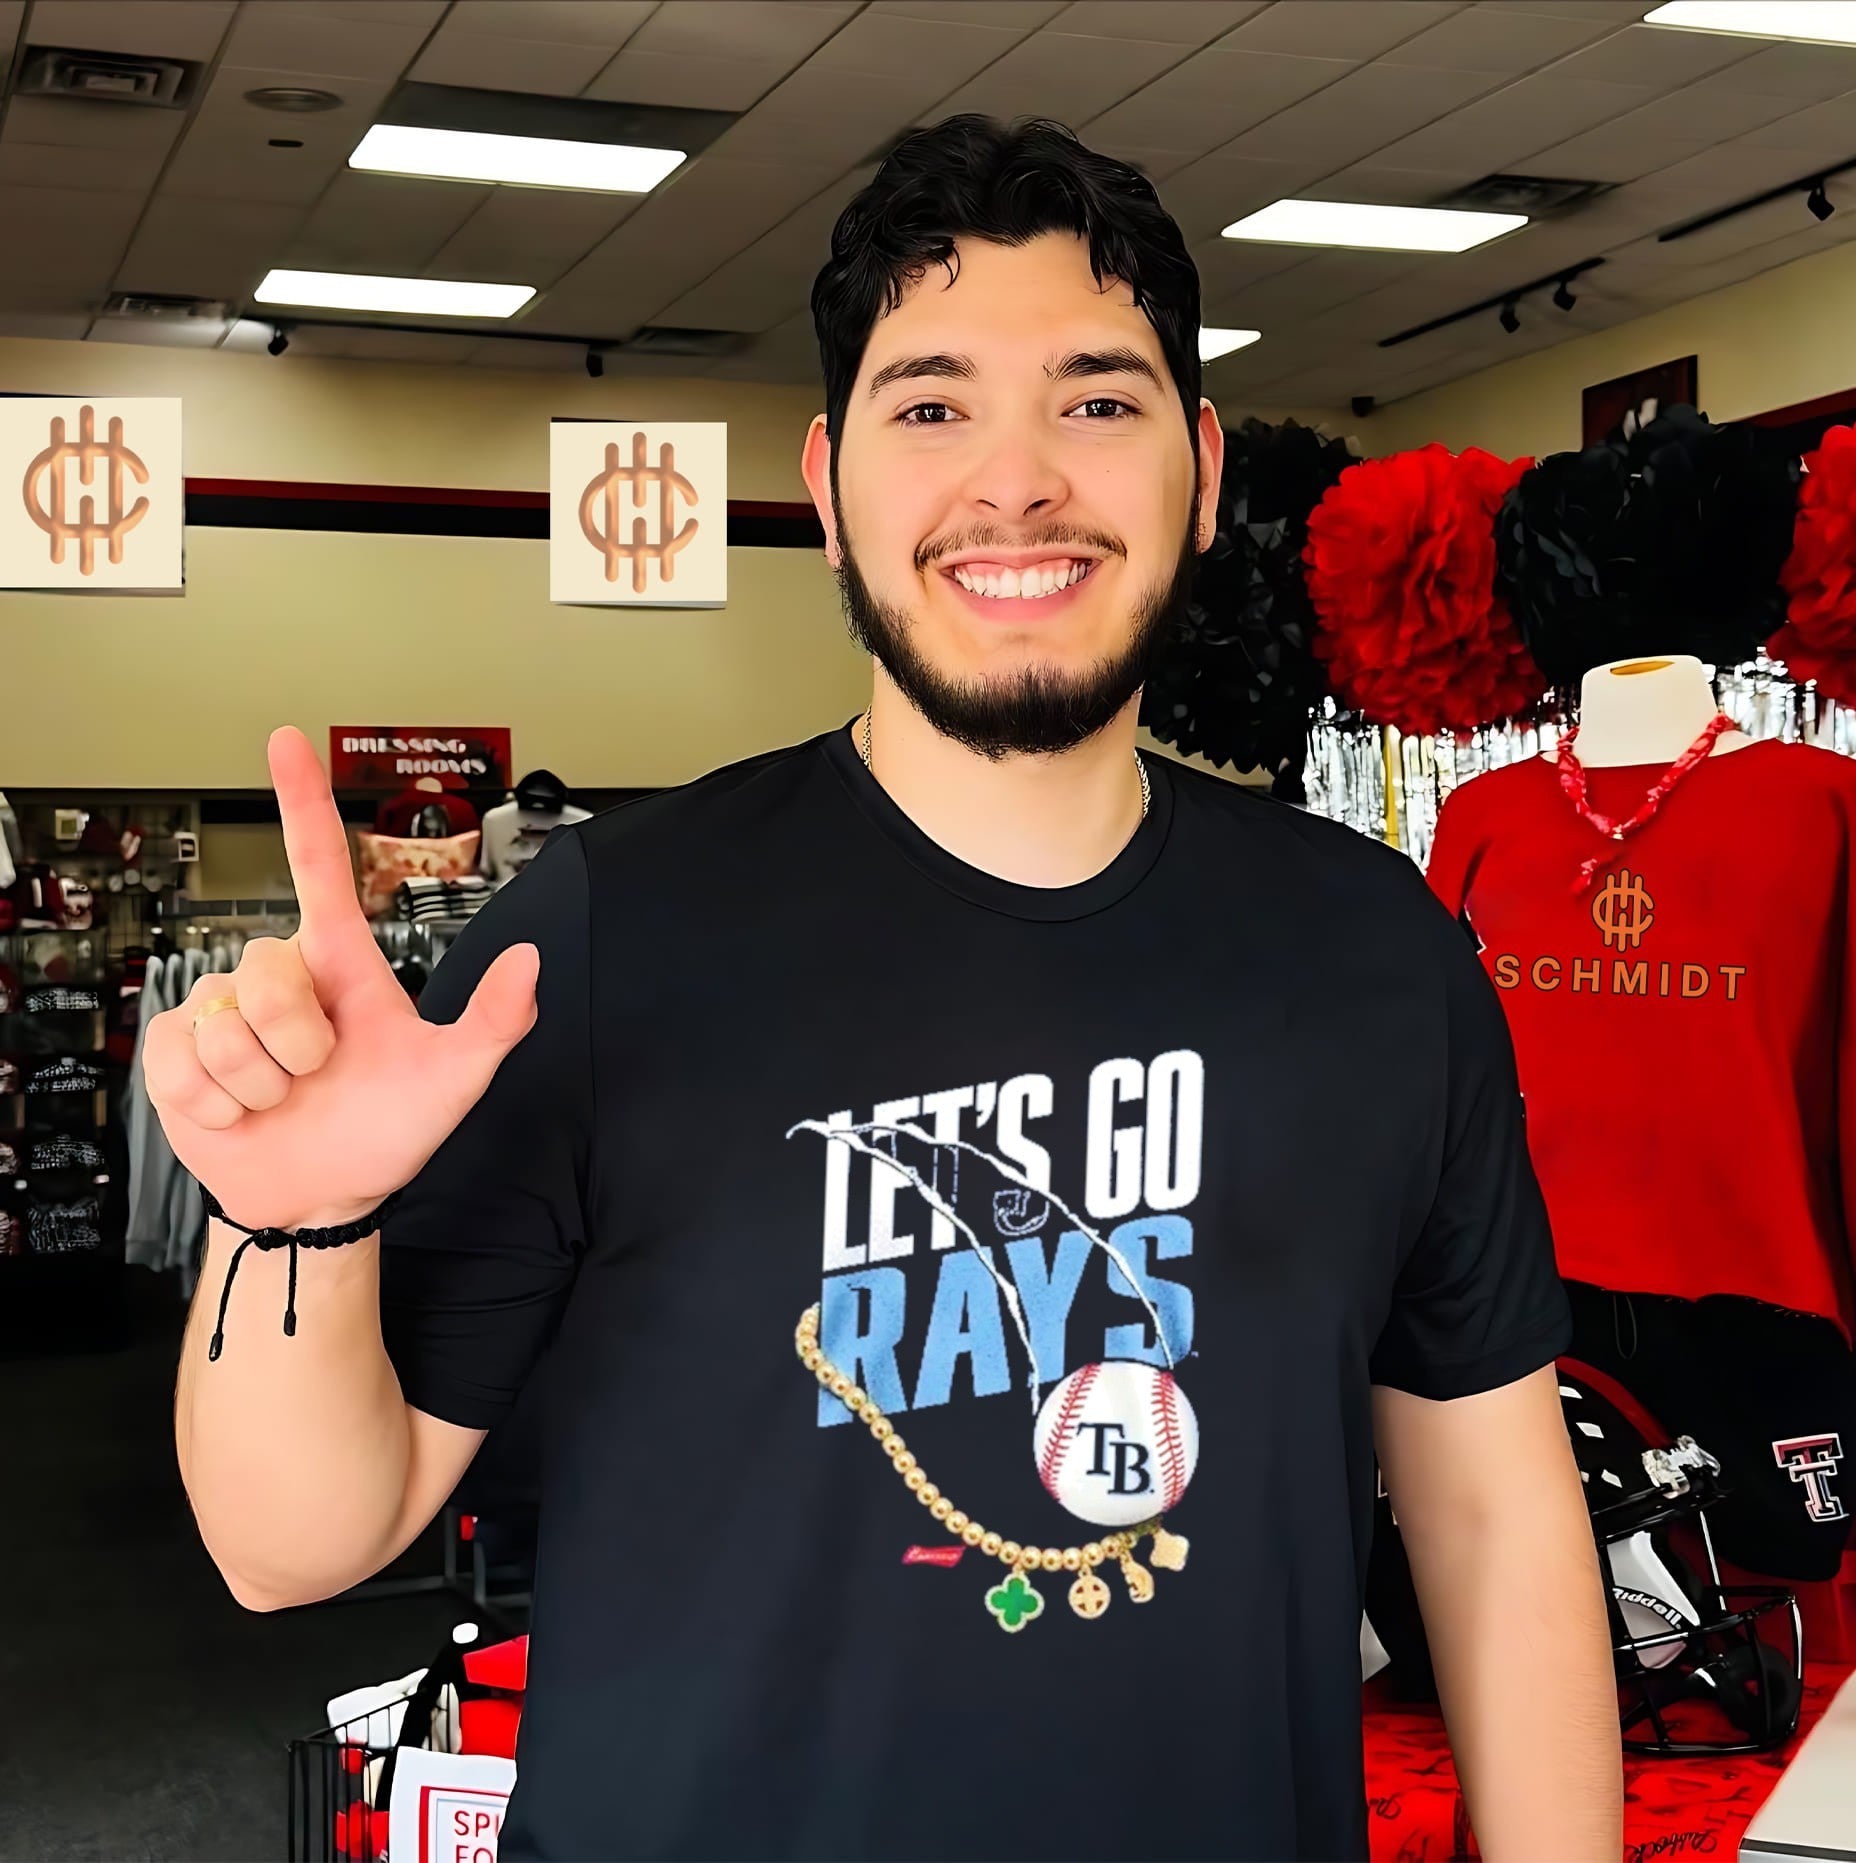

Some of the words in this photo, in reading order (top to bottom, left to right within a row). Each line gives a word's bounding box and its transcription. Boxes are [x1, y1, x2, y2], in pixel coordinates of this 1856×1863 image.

[342, 737, 467, 754] DRESSING
[396, 758, 487, 775] ROOMS
[1494, 953, 1747, 1001] SCHMIDT
[822, 1072, 1054, 1272] LET'S
[1084, 1049, 1205, 1220] GO
[817, 1214, 1194, 1428] RAYS
[1076, 1422, 1151, 1495] TB
